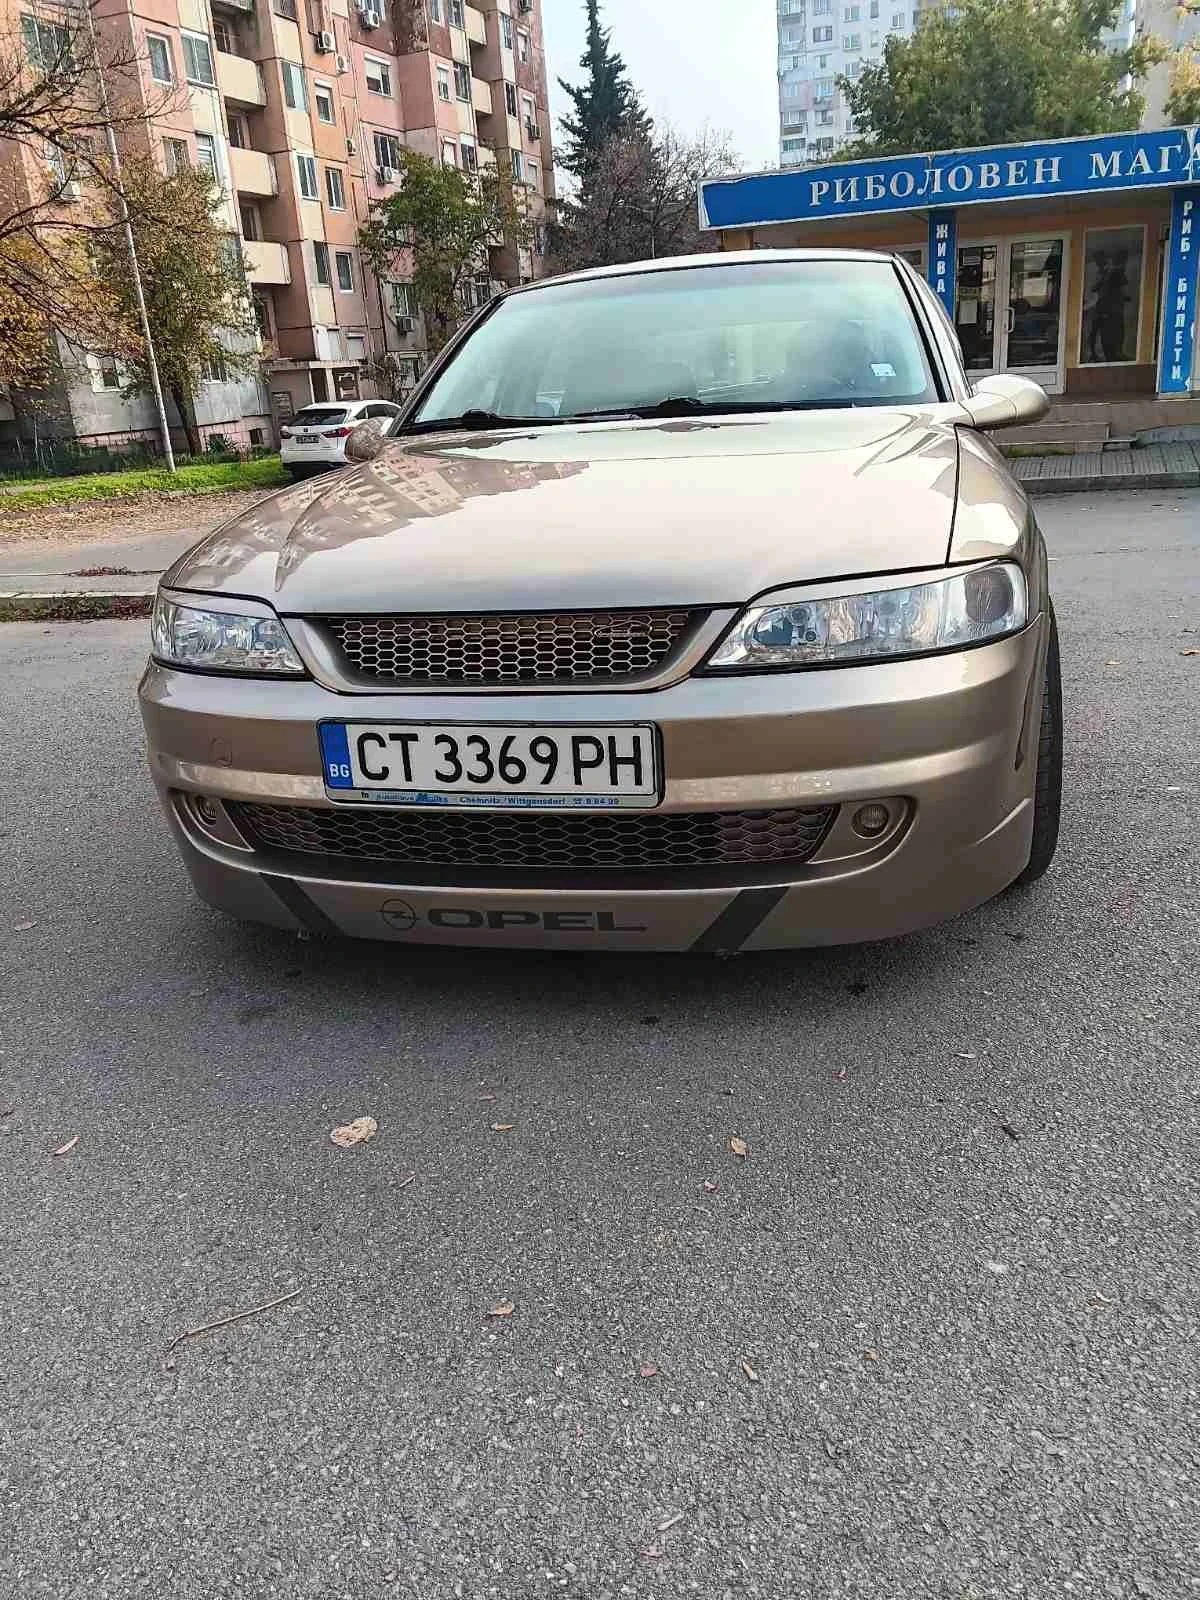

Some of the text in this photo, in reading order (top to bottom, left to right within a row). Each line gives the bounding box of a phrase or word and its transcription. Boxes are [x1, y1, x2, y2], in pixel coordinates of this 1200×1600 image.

[809, 156, 1062, 207] РИБОЛОВЕН
[936, 224, 949, 293] ЖИВА
[1171, 277, 1188, 380] БИЛЕТИ
[329, 763, 350, 778] BG
[356, 732, 643, 786] CT 3369 PH
[427, 908, 648, 932] OPEL
